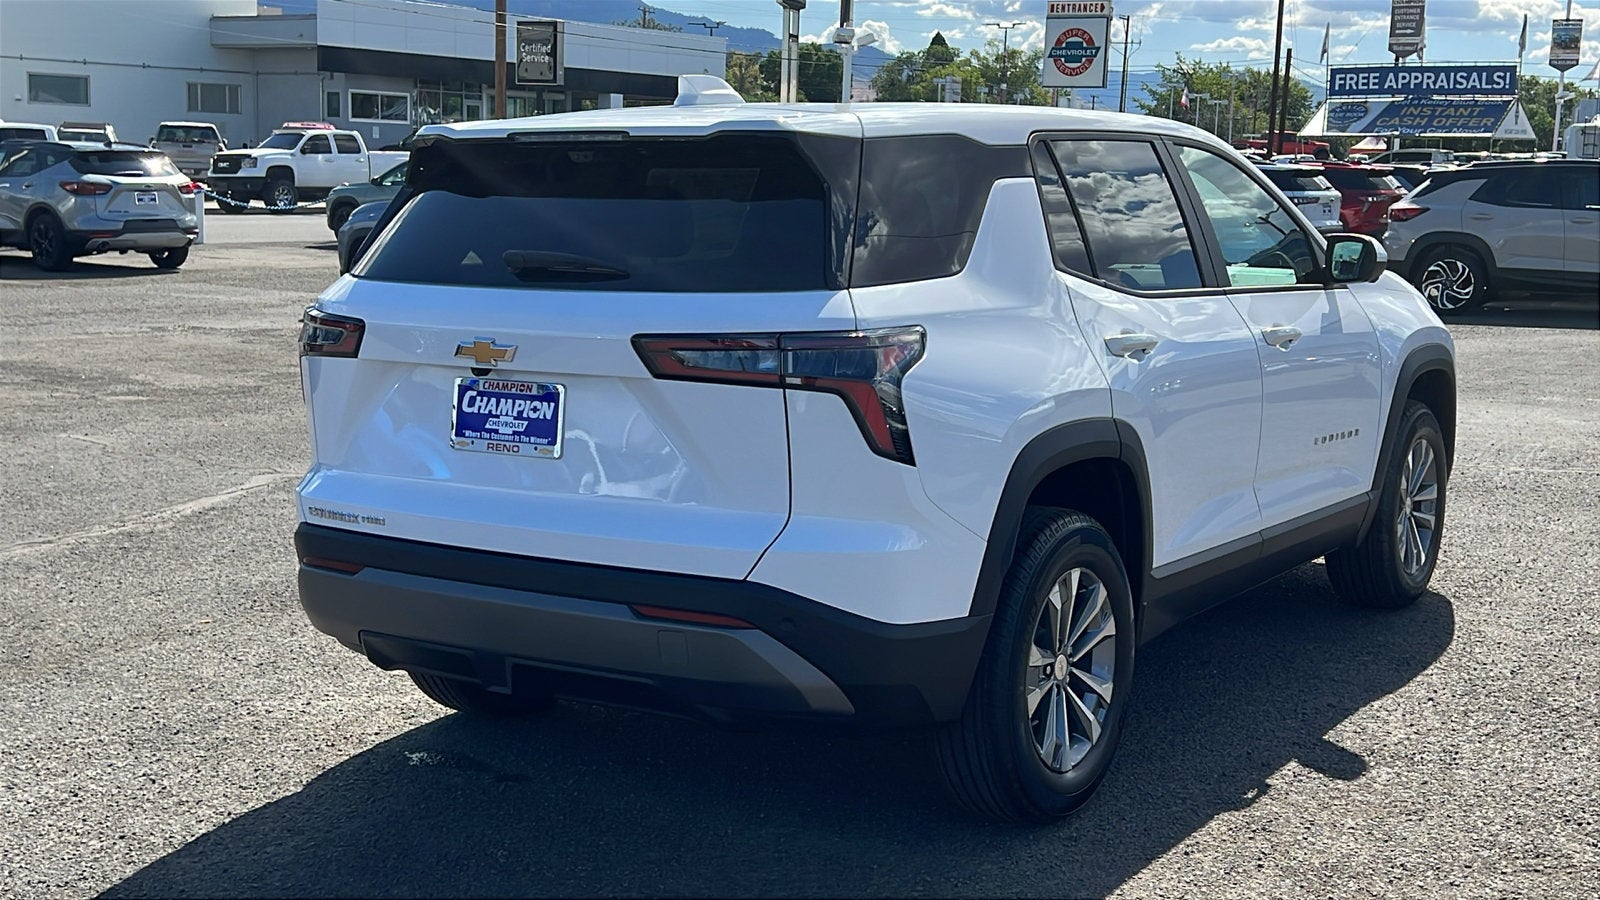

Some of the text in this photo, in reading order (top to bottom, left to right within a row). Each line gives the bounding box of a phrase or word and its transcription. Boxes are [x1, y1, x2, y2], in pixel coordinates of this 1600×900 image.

[1056, 3, 1099, 13] ENTRANCE
[1060, 29, 1090, 42] SUPER
[520, 43, 551, 53] Certified
[521, 52, 550, 63] Service
[1055, 60, 1091, 76] SERVICE
[1334, 71, 1511, 90] FREE APPRAISALS!
[1400, 107, 1484, 116] INSTANT
[1376, 117, 1495, 127] CASH OFFER
[1397, 126, 1424, 134] Your
[482, 380, 534, 394] CHAMPION
[462, 390, 556, 420] CHAMPION
[488, 419, 525, 430] CHEVROLET
[486, 442, 520, 454] RENO
